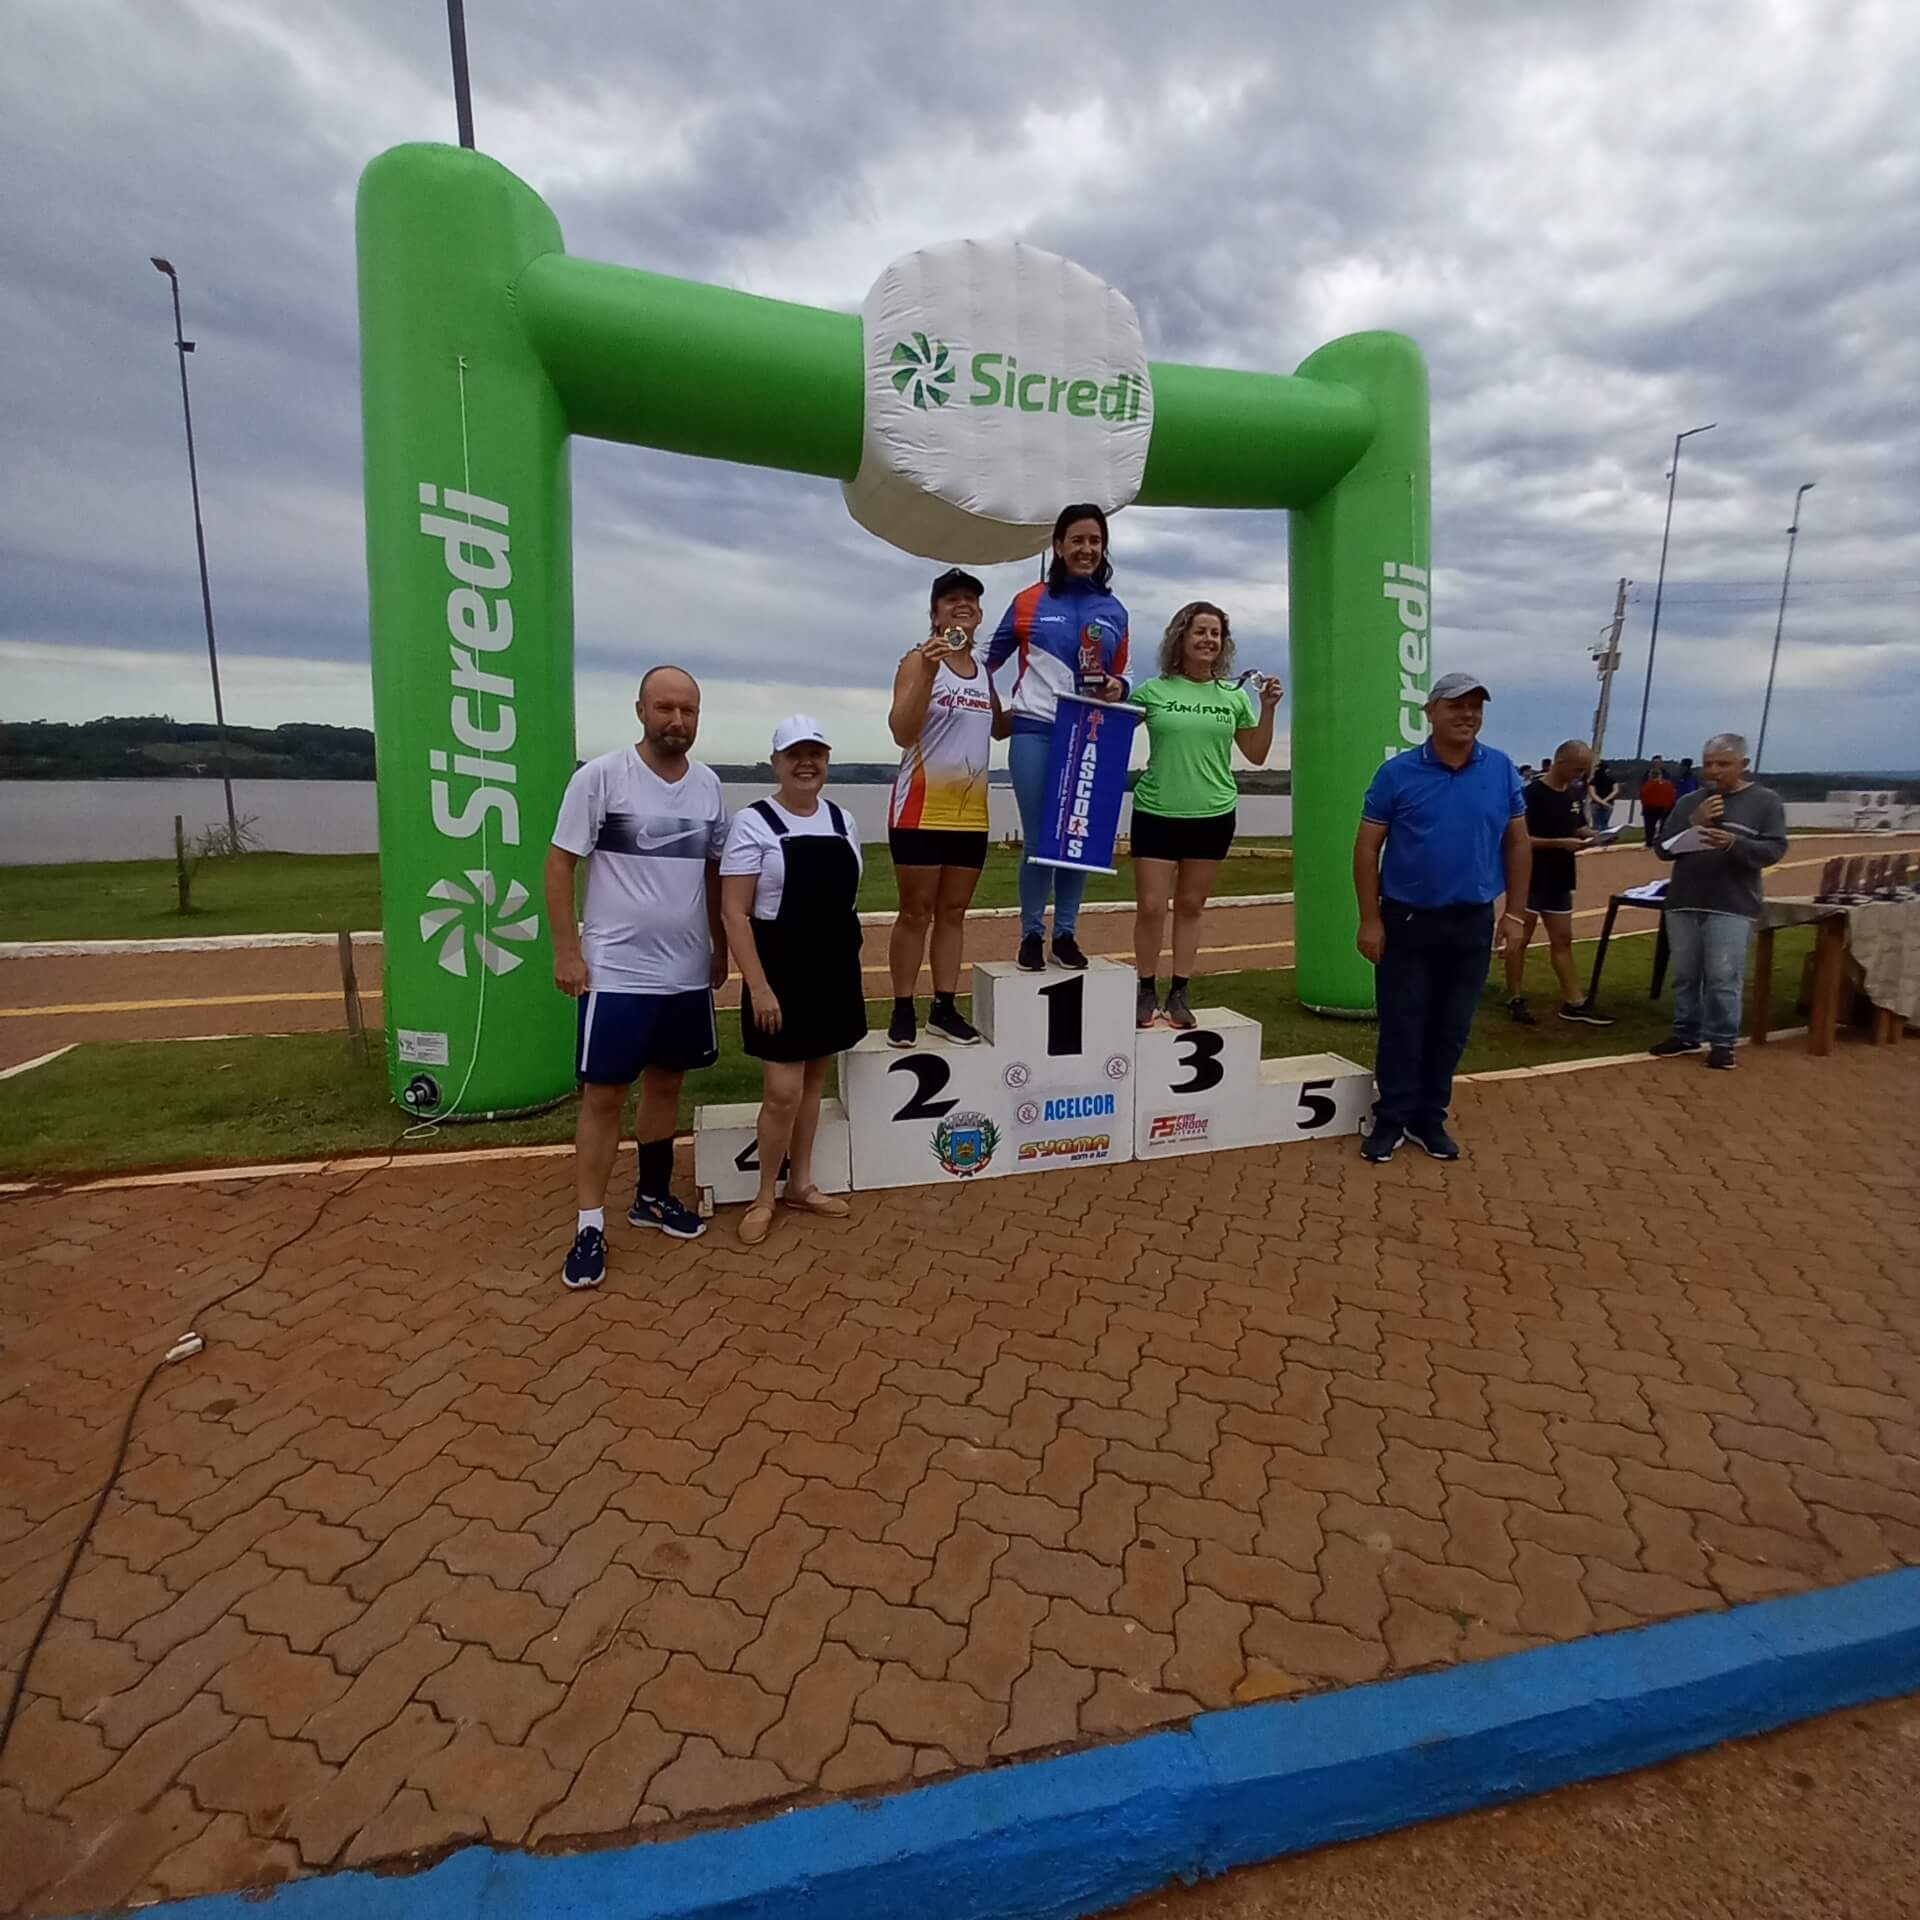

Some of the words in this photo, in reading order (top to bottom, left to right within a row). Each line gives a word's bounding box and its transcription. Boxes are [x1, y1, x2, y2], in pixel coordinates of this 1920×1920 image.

[969, 353, 1141, 422] Sicredi
[419, 481, 519, 846] Sicredi
[1037, 975, 1084, 1056] 1
[887, 1053, 960, 1122] 2
[1168, 1030, 1225, 1094] 3
[1044, 1094, 1115, 1121] ACELCOR
[1296, 1080, 1337, 1129] 5
